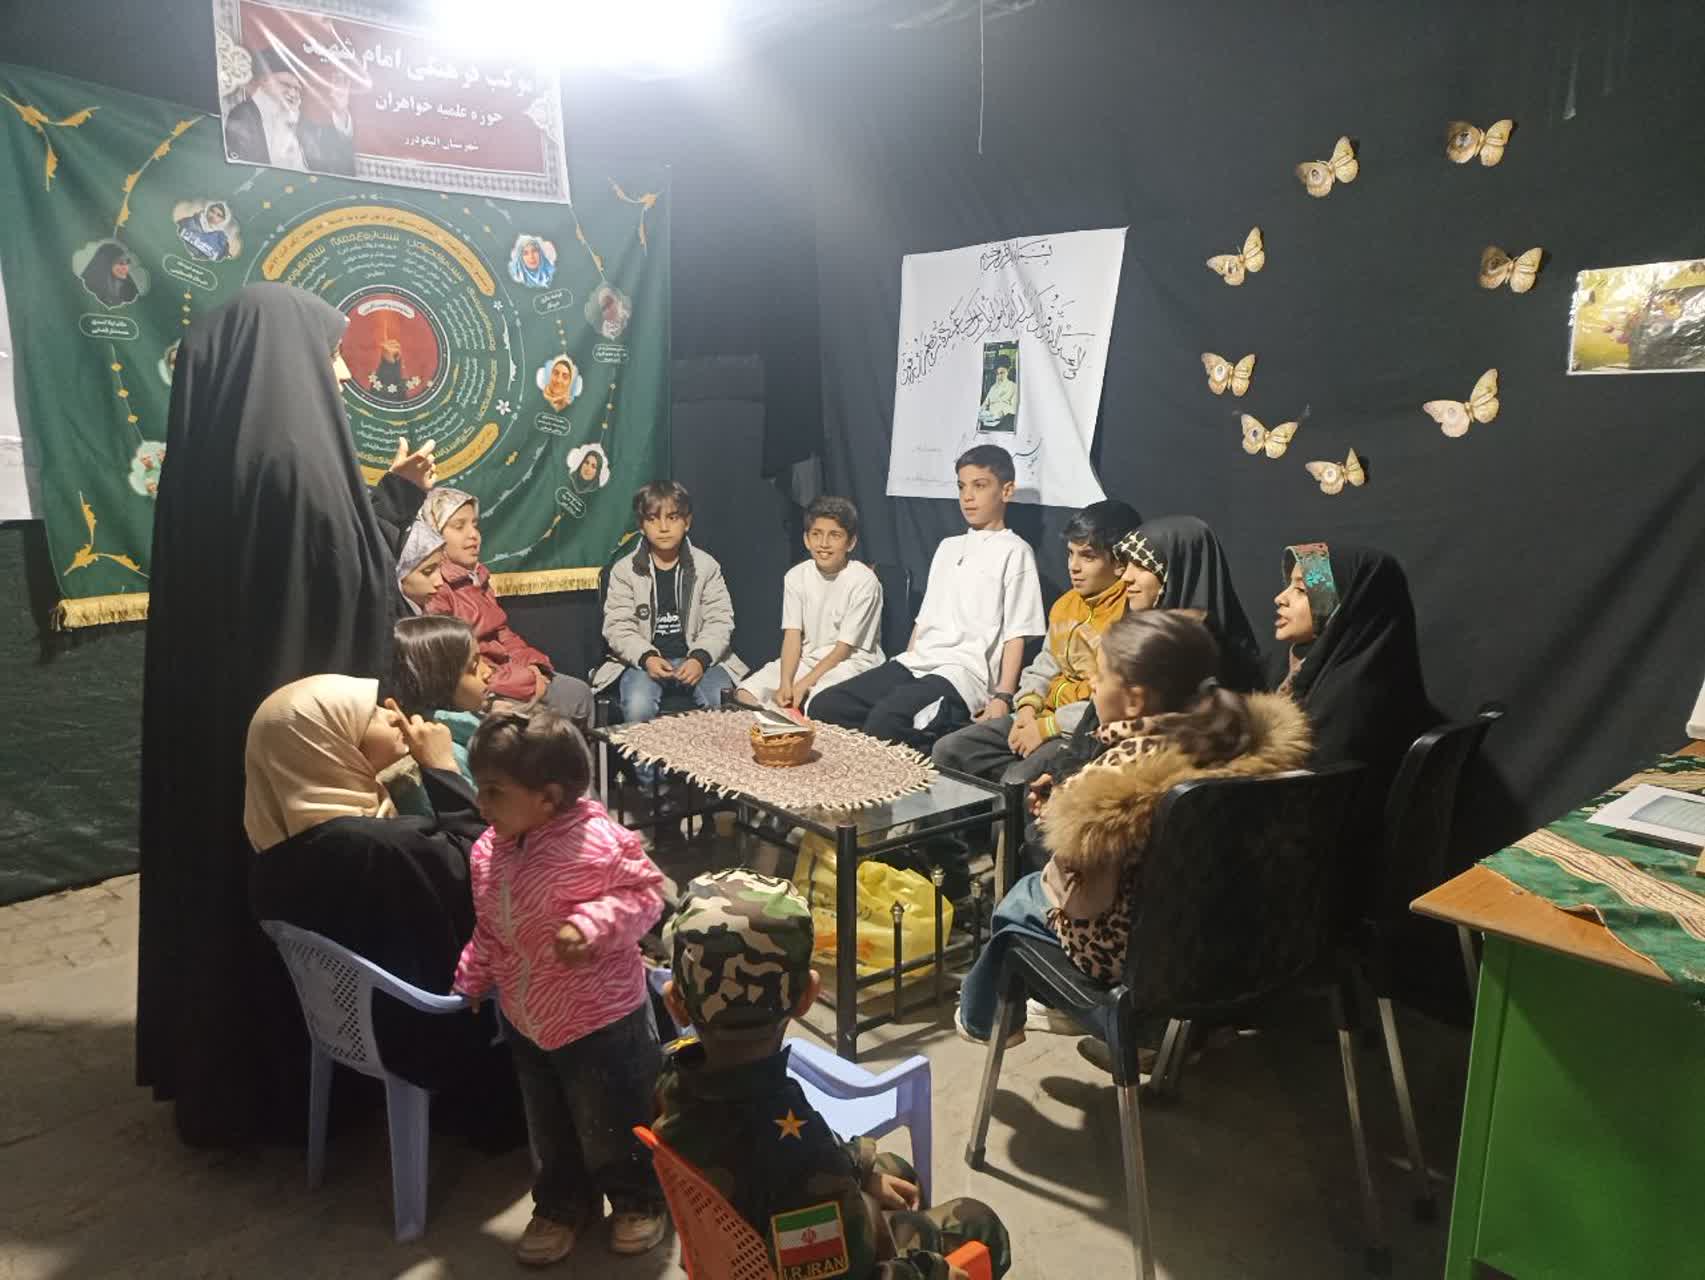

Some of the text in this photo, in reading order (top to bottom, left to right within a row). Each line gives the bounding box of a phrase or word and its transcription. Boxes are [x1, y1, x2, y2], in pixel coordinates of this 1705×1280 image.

[303, 37, 357, 63] شهید
[361, 43, 401, 71] امام
[407, 55, 480, 88] فرهنگی
[375, 90, 503, 127] حوزه علمیه خواهران
[441, 136, 479, 153] شهرستان
